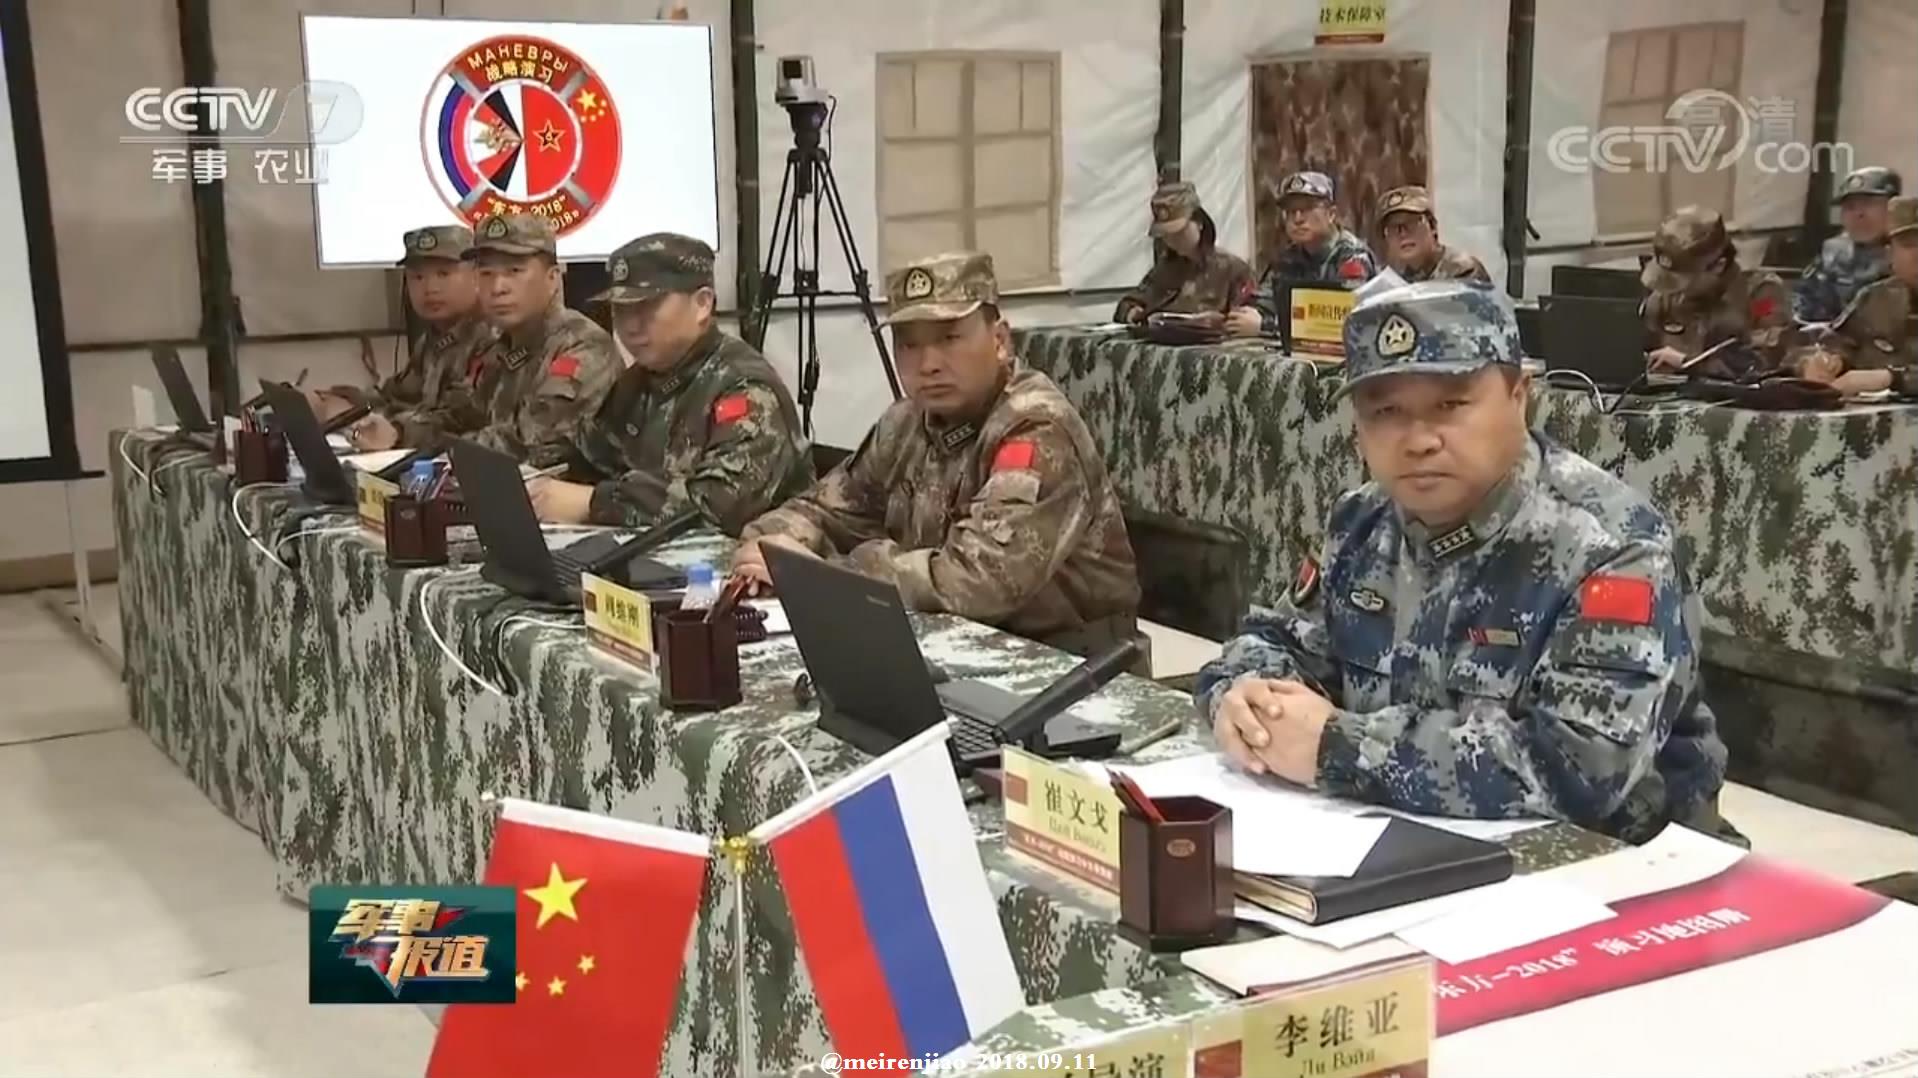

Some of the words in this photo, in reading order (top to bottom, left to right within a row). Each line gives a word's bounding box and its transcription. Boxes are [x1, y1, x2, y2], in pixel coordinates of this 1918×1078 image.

[467, 43, 569, 73] МАНЕВРЫ
[485, 60, 554, 83] 战略演习
[1276, 992, 1399, 1059] 李维亚
